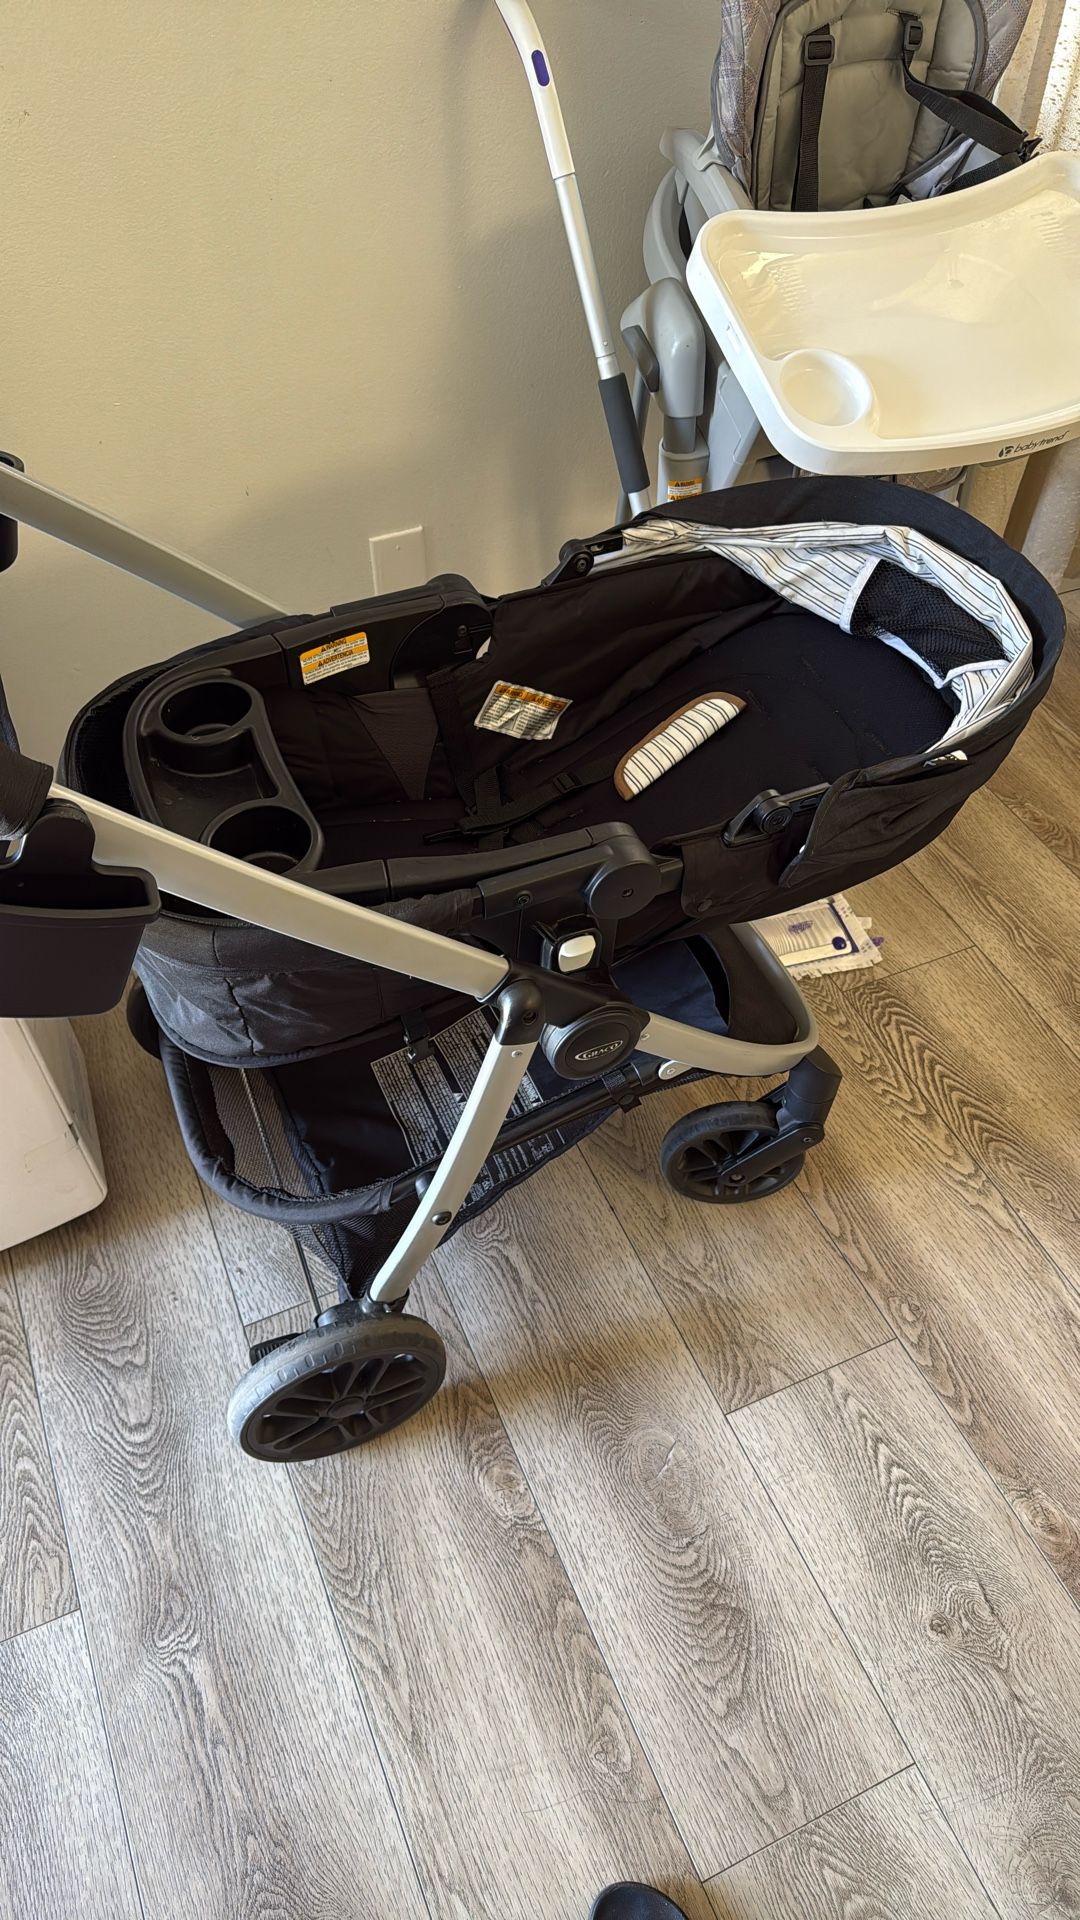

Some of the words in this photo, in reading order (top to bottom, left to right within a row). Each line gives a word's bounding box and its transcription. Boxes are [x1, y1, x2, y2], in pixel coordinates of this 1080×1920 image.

[1014, 430, 1070, 453] babytrend
[323, 650, 354, 664] ADVERTENCIA
[582, 1042, 619, 1060] GRACO
